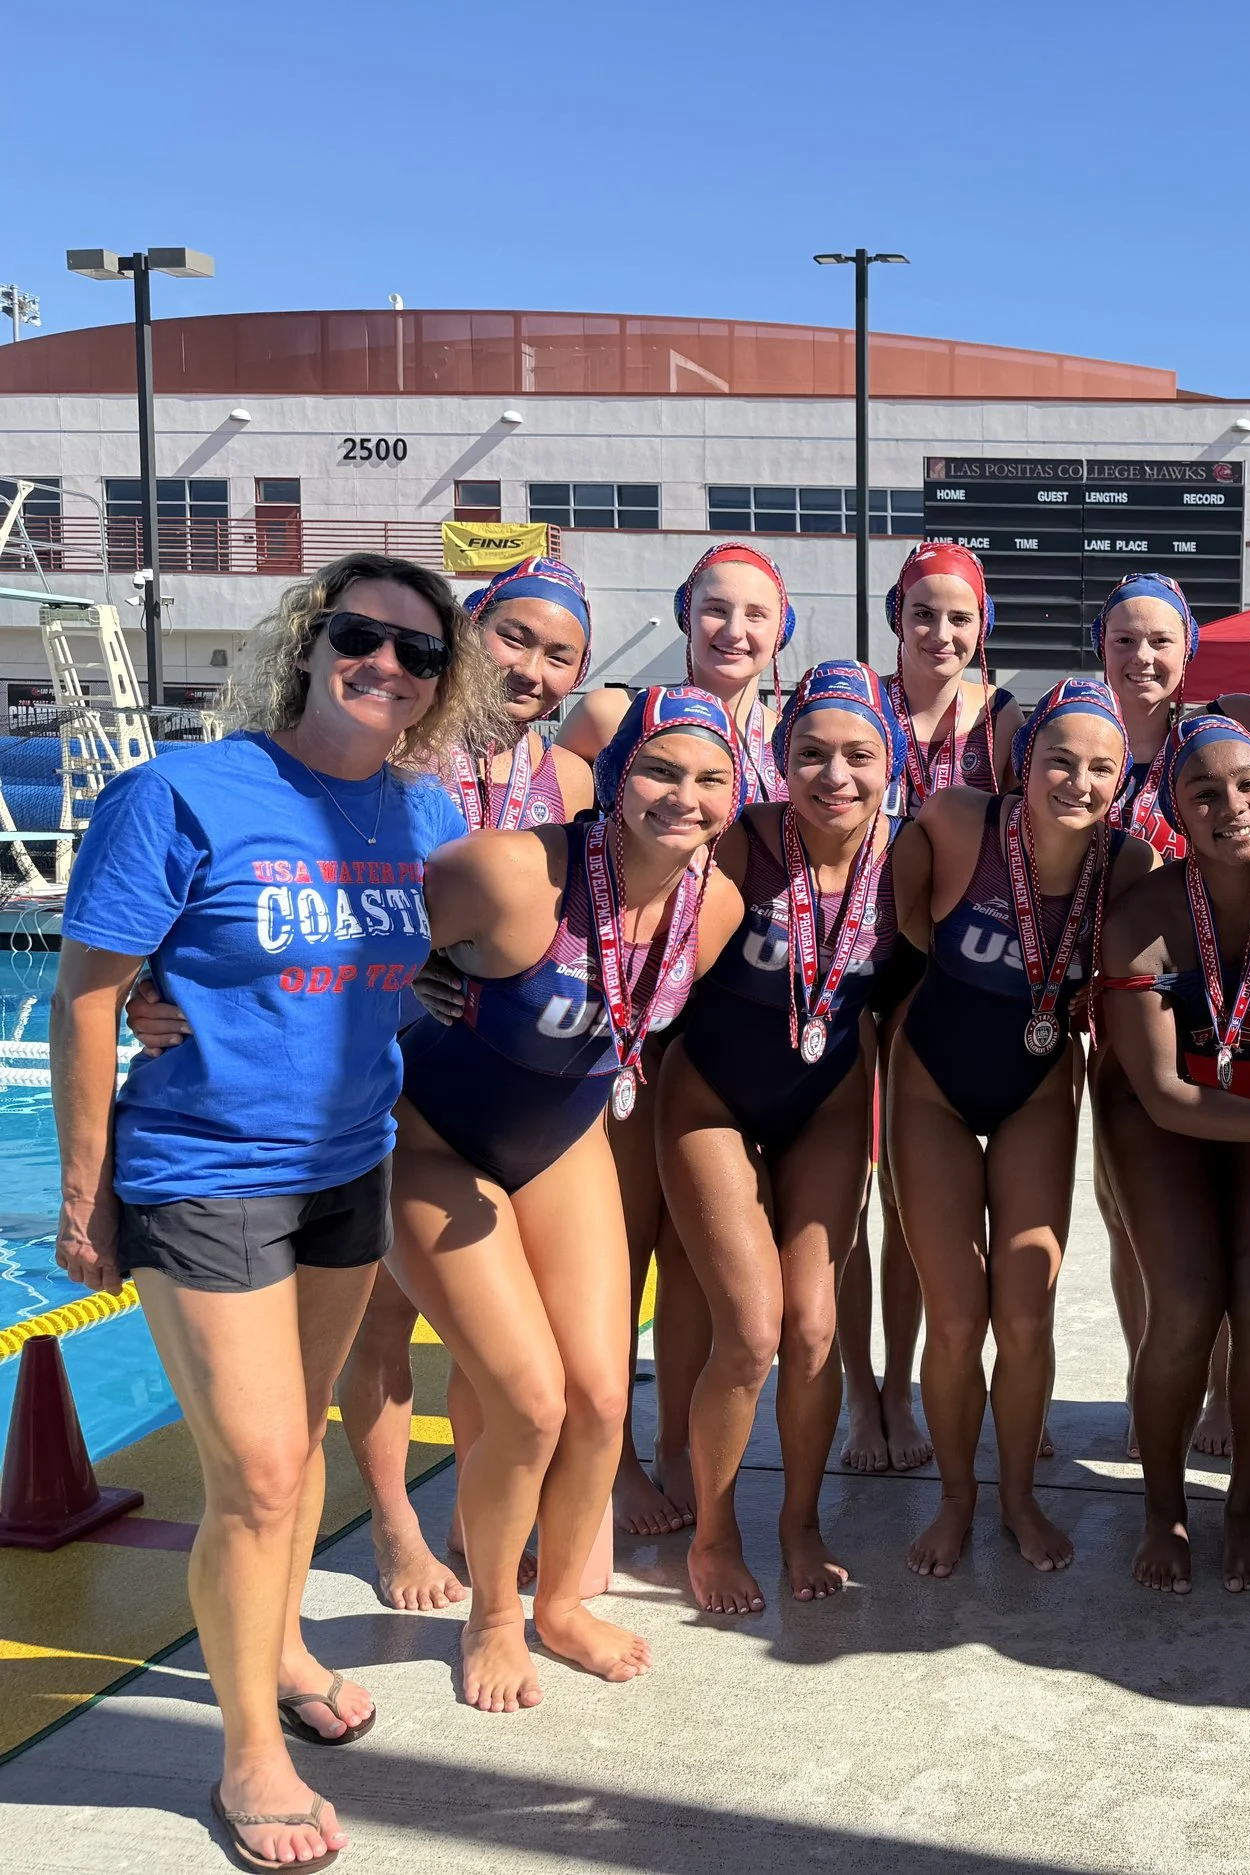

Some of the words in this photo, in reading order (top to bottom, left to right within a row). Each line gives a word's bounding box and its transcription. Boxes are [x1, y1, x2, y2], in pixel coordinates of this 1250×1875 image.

[342, 437, 408, 462] 2500
[950, 463, 980, 476] LAS
[985, 464, 1053, 477] POSITAS
[1058, 465, 1140, 479] COLLEGE
[1145, 466, 1207, 480] HAWKS
[936, 489, 966, 500] HOME
[1037, 491, 1069, 502] GUEST
[1085, 492, 1128, 503] LENGTHS
[1183, 493, 1225, 505] RECORD
[468, 538, 522, 549] FINIS
[958, 537, 990, 548] PLACE
[1014, 538, 1039, 549] TIME
[1084, 540, 1111, 550] LANE
[1116, 540, 1148, 551] PLACE
[1172, 541, 1197, 552] TIME
[464, 789, 480, 832] PROGRA
[503, 806, 521, 831] MPIC
[252, 861, 314, 883] USA
[316, 861, 395, 884] WATER
[972, 902, 1010, 922] Delfina
[1009, 836, 1030, 909] DEVELOPMENT
[1021, 914, 1039, 963] PROGRAM
[1058, 922, 1077, 964] OLYMPIC
[1073, 846, 1096, 917] DEVELOPMENT
[258, 886, 432, 954] COASTA
[750, 903, 789, 922] Delfina
[589, 855, 614, 941] DEVELOPMENT
[602, 949, 622, 1006] PROGRAM
[798, 912, 816, 964] PROGRAM
[835, 927, 856, 970] OLYMPIC
[280, 965, 358, 994] ODP
[556, 963, 597, 981] Delfina
